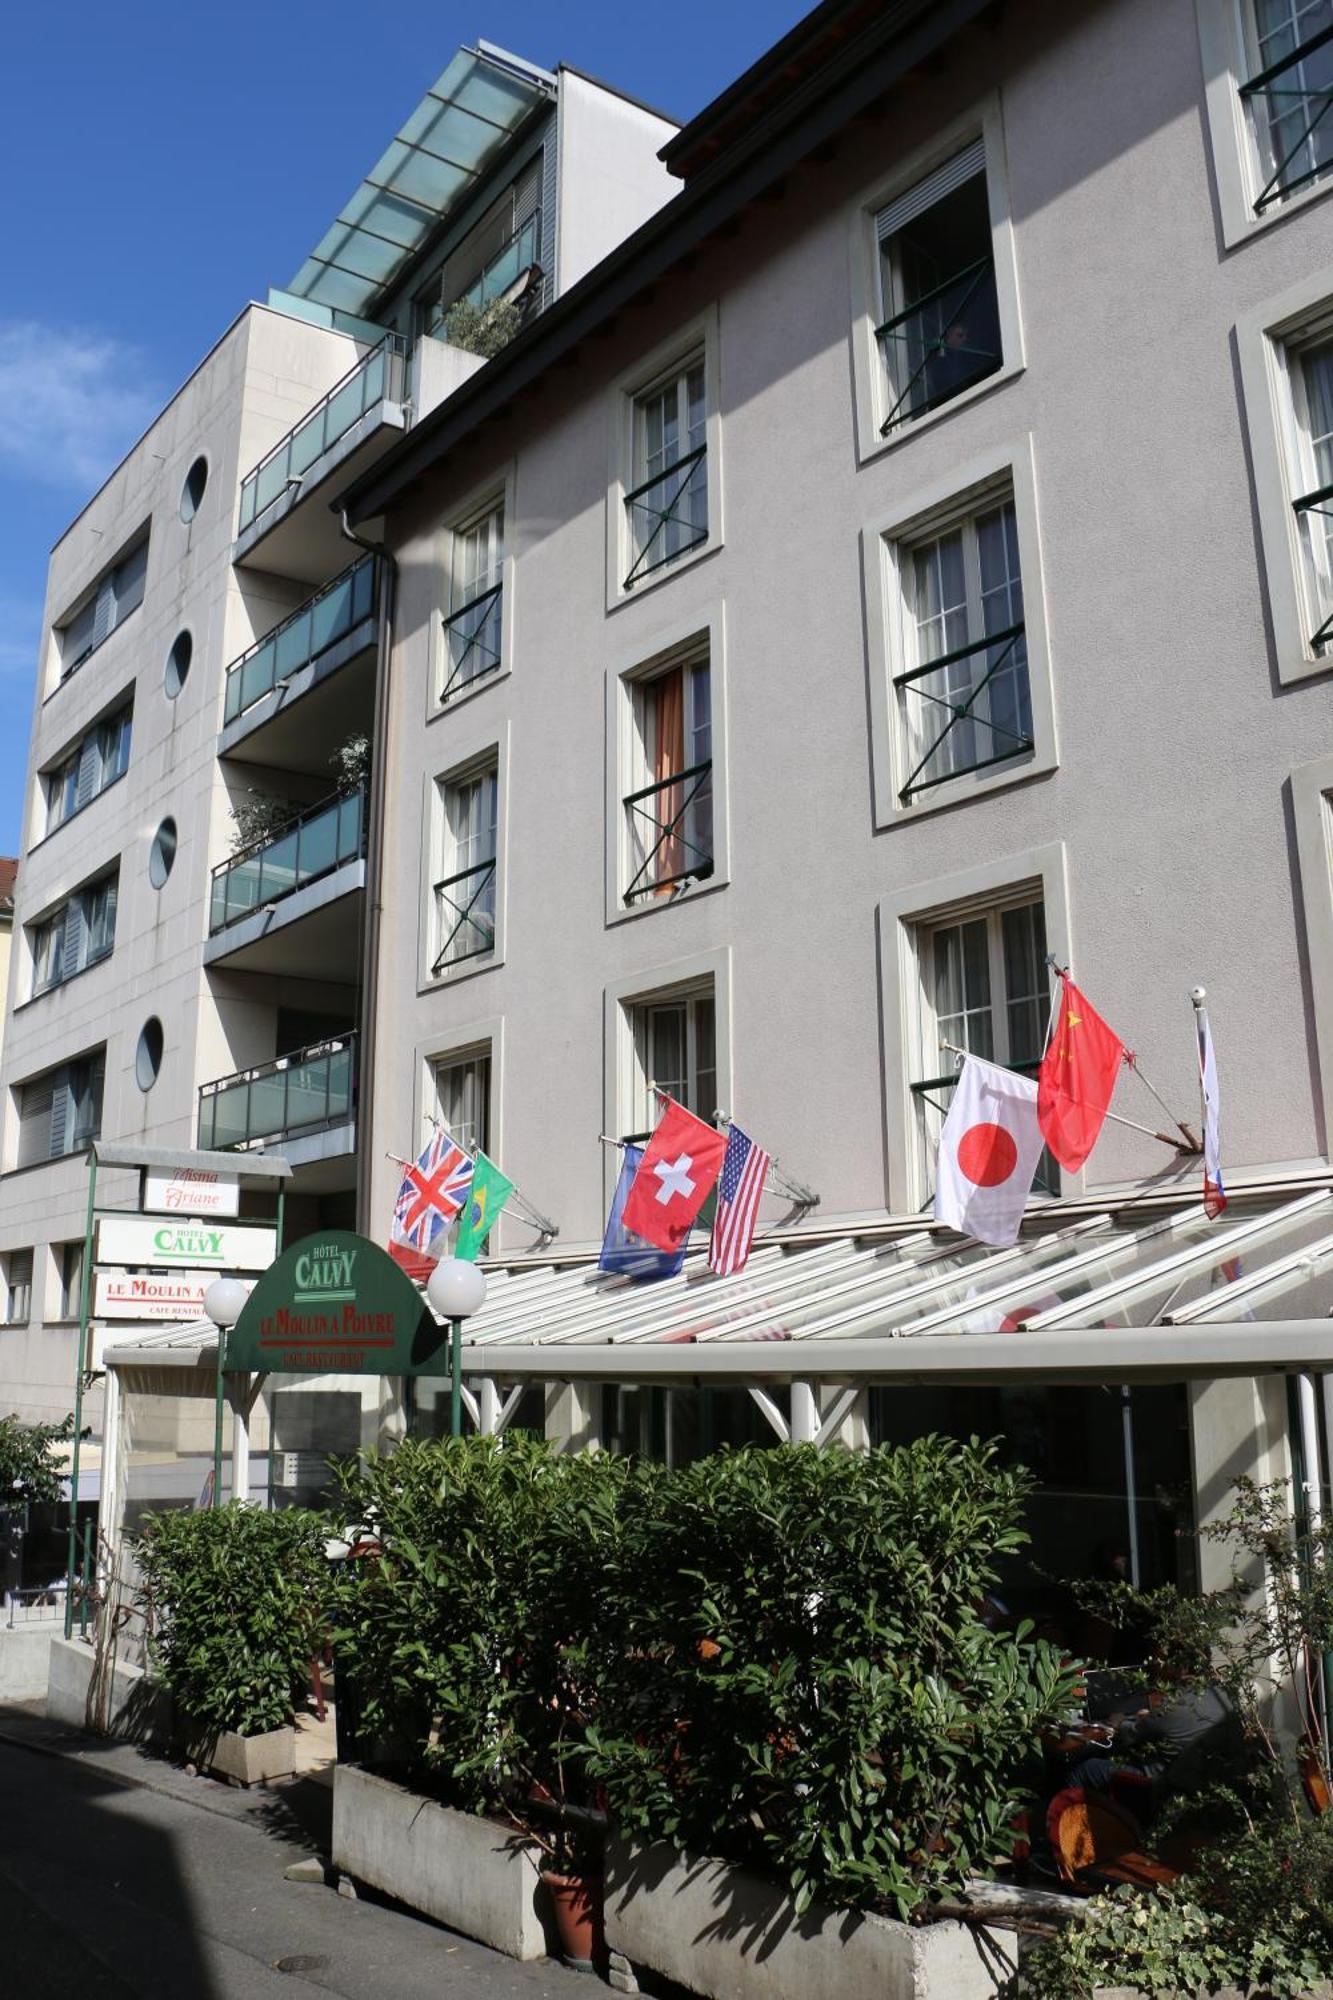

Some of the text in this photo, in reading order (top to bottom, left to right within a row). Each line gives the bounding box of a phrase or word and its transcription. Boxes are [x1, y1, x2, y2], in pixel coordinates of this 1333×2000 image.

[154, 1230, 225, 1253] CALVY
[295, 1249, 358, 1290] CALVY
[107, 1284, 125, 1295] LE
[132, 1280, 191, 1297] MOULIN
[260, 1316, 273, 1336] LE
[276, 1308, 328, 1336] MOULIN
[342, 1303, 395, 1335] POIVRE
